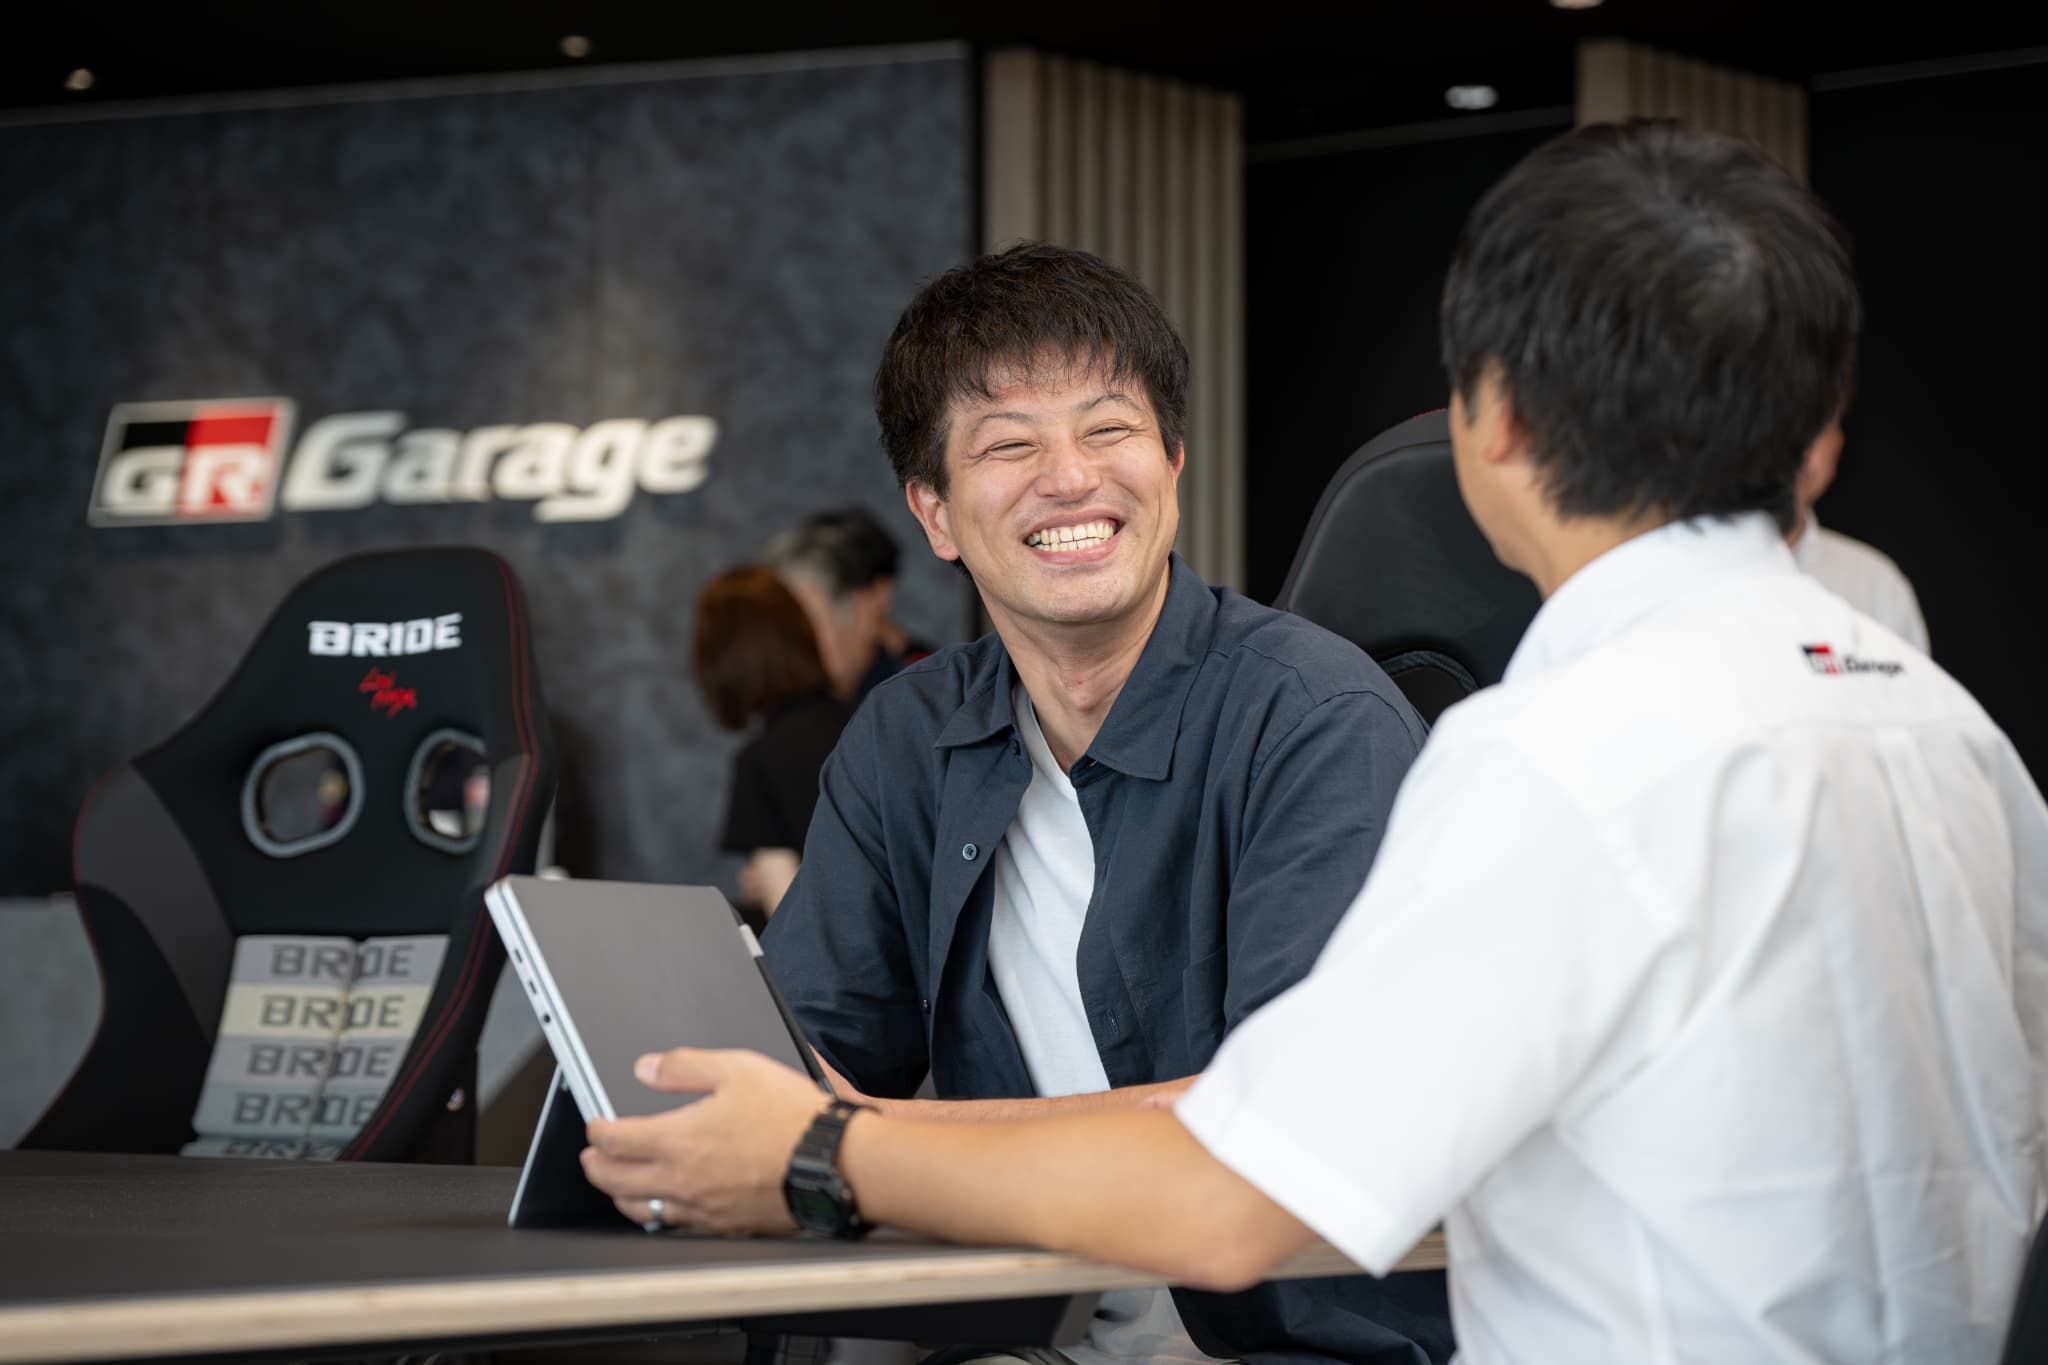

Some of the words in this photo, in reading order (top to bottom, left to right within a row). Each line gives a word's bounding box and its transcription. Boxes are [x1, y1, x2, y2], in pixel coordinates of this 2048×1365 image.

[104, 446, 272, 516] GR
[281, 411, 715, 521] Garage
[308, 612, 463, 657] BRIDE
[270, 944, 414, 979] BRDE
[260, 995, 404, 1029] BRDE
[248, 1044, 393, 1078] BRDE
[233, 1093, 377, 1127] BRDE
